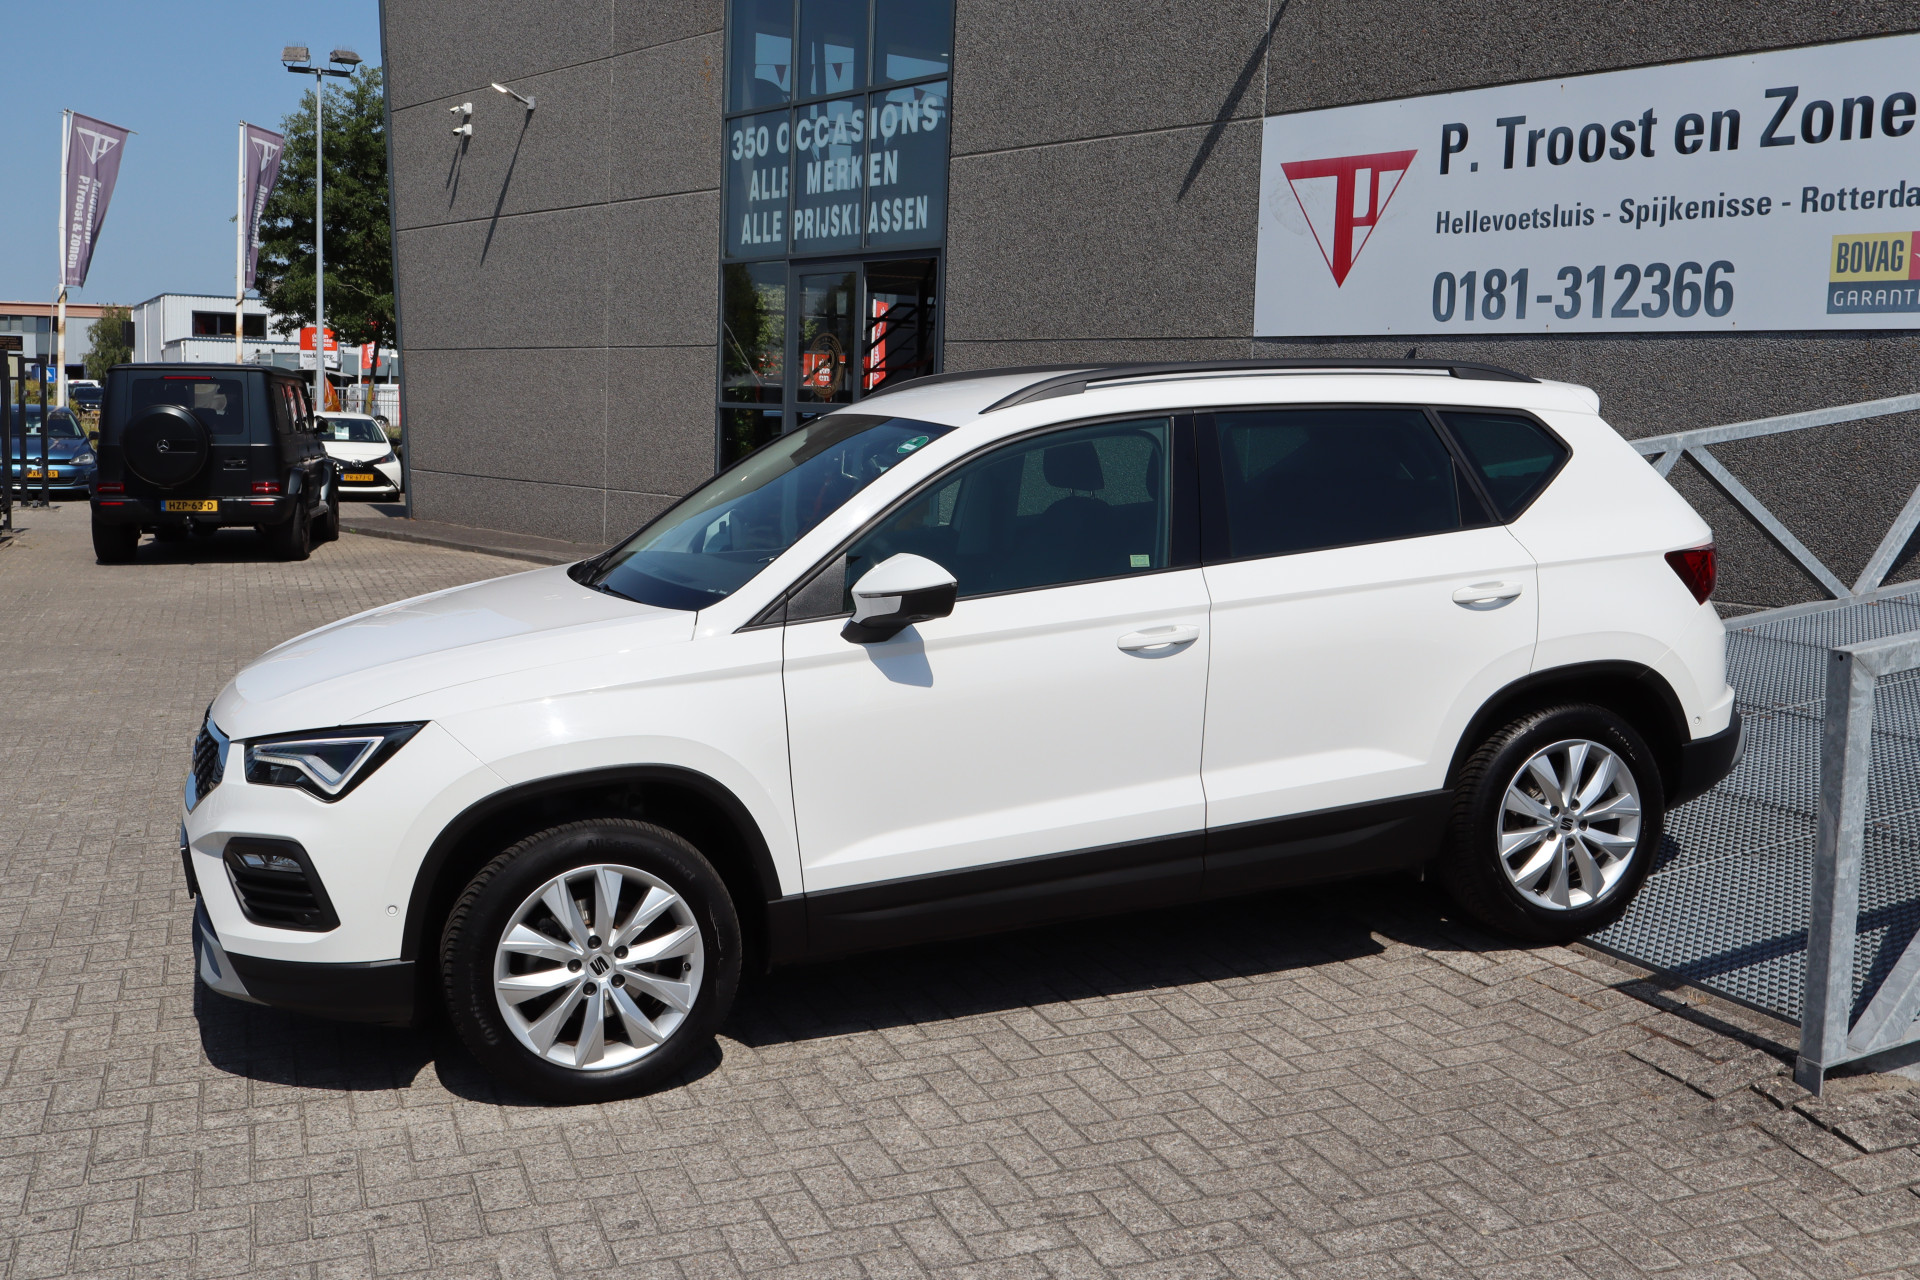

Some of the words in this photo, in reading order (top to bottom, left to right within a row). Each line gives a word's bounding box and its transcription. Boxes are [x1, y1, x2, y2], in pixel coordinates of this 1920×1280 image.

[732, 126, 769, 161] 350
[776, 97, 939, 154] OCCASIONS
[1439, 122, 1479, 176] P.
[1496, 107, 1657, 171] Troost
[1674, 105, 1742, 155] en
[749, 166, 789, 202] ALLE
[806, 150, 899, 195] MERKEN
[741, 210, 782, 245] ALLE
[794, 195, 928, 240] PRIJSKLASSEN
[1435, 203, 1596, 235] Hellevoetsluis
[1619, 191, 1772, 230] Spijkenisse
[1836, 239, 1905, 274] BOVAG
[1432, 260, 1736, 322] 0181-312366
[168, 501, 214, 510] HZP-63-D
